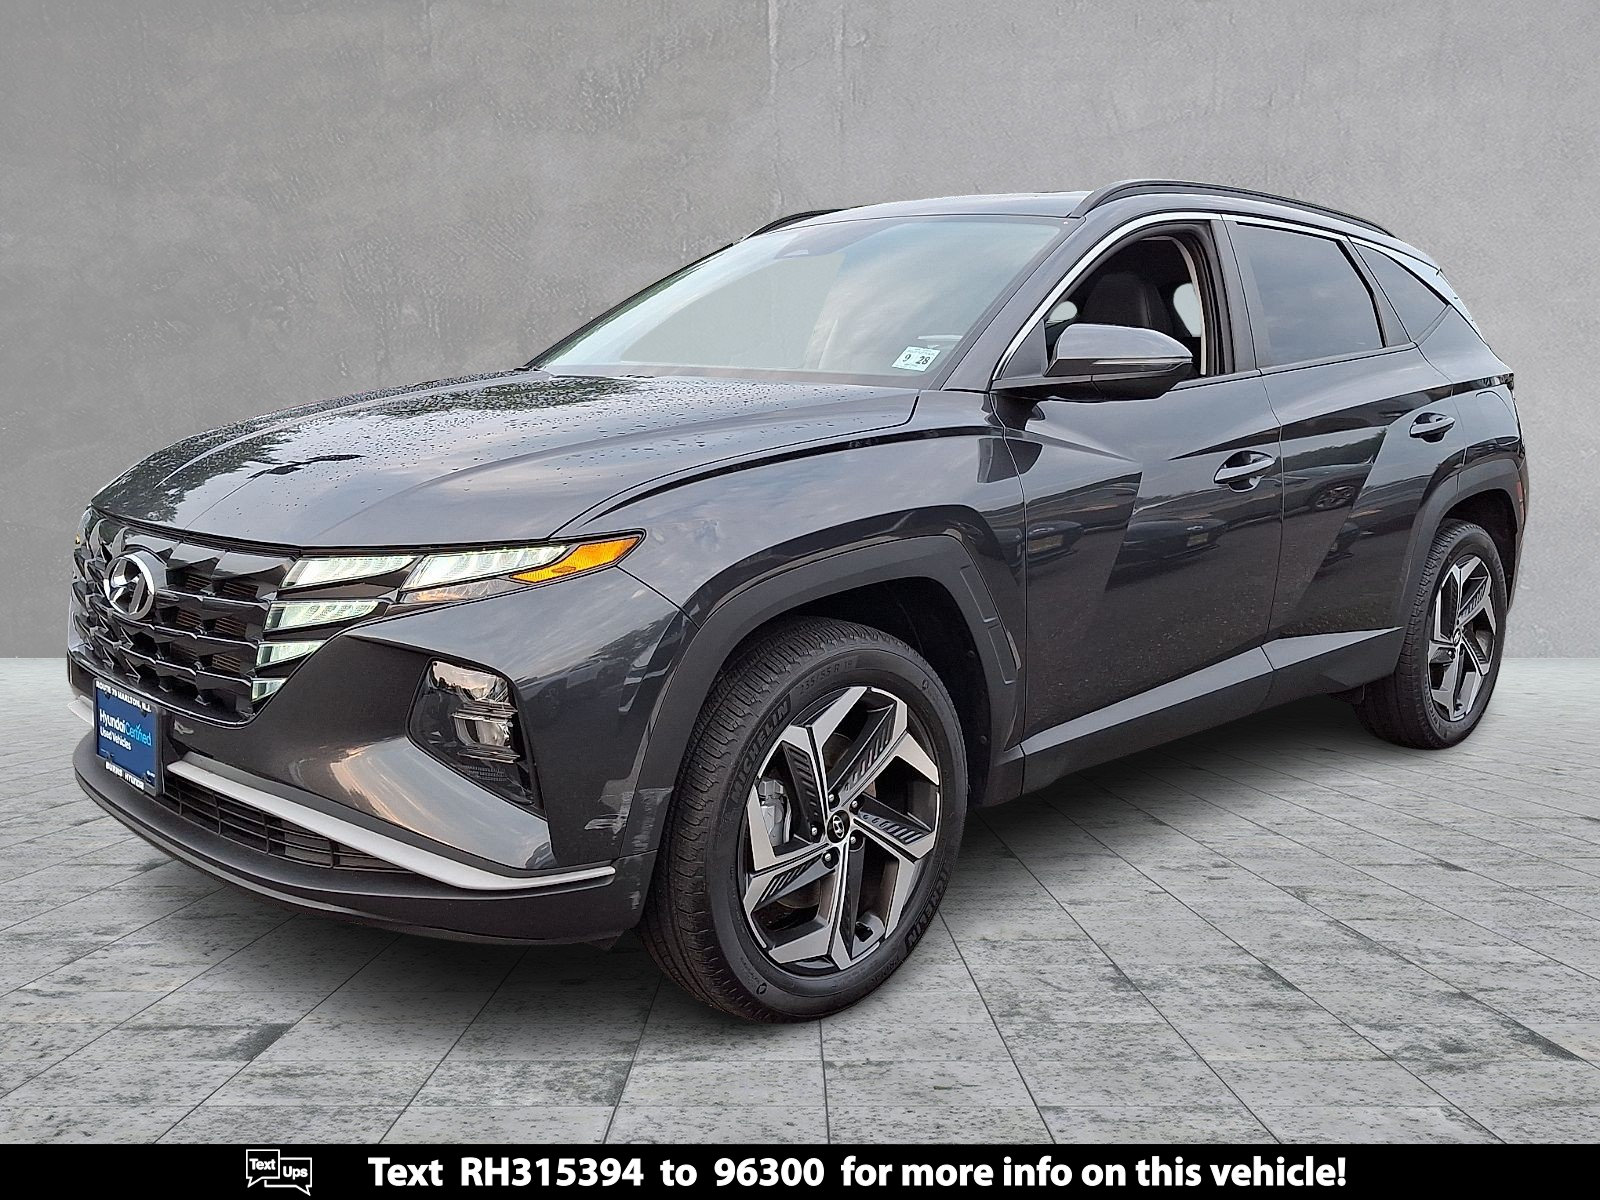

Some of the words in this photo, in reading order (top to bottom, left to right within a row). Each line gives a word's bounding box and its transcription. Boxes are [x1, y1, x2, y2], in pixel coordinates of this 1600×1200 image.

[903, 354, 911, 362] 9
[915, 355, 931, 365] 28
[96, 680, 111, 694] ROUTE
[100, 708, 125, 734] Hyundai
[125, 721, 152, 746] Certified
[100, 726, 112, 740] Used
[112, 731, 132, 751] Vehicles
[731, 698, 788, 802] MICHELIN
